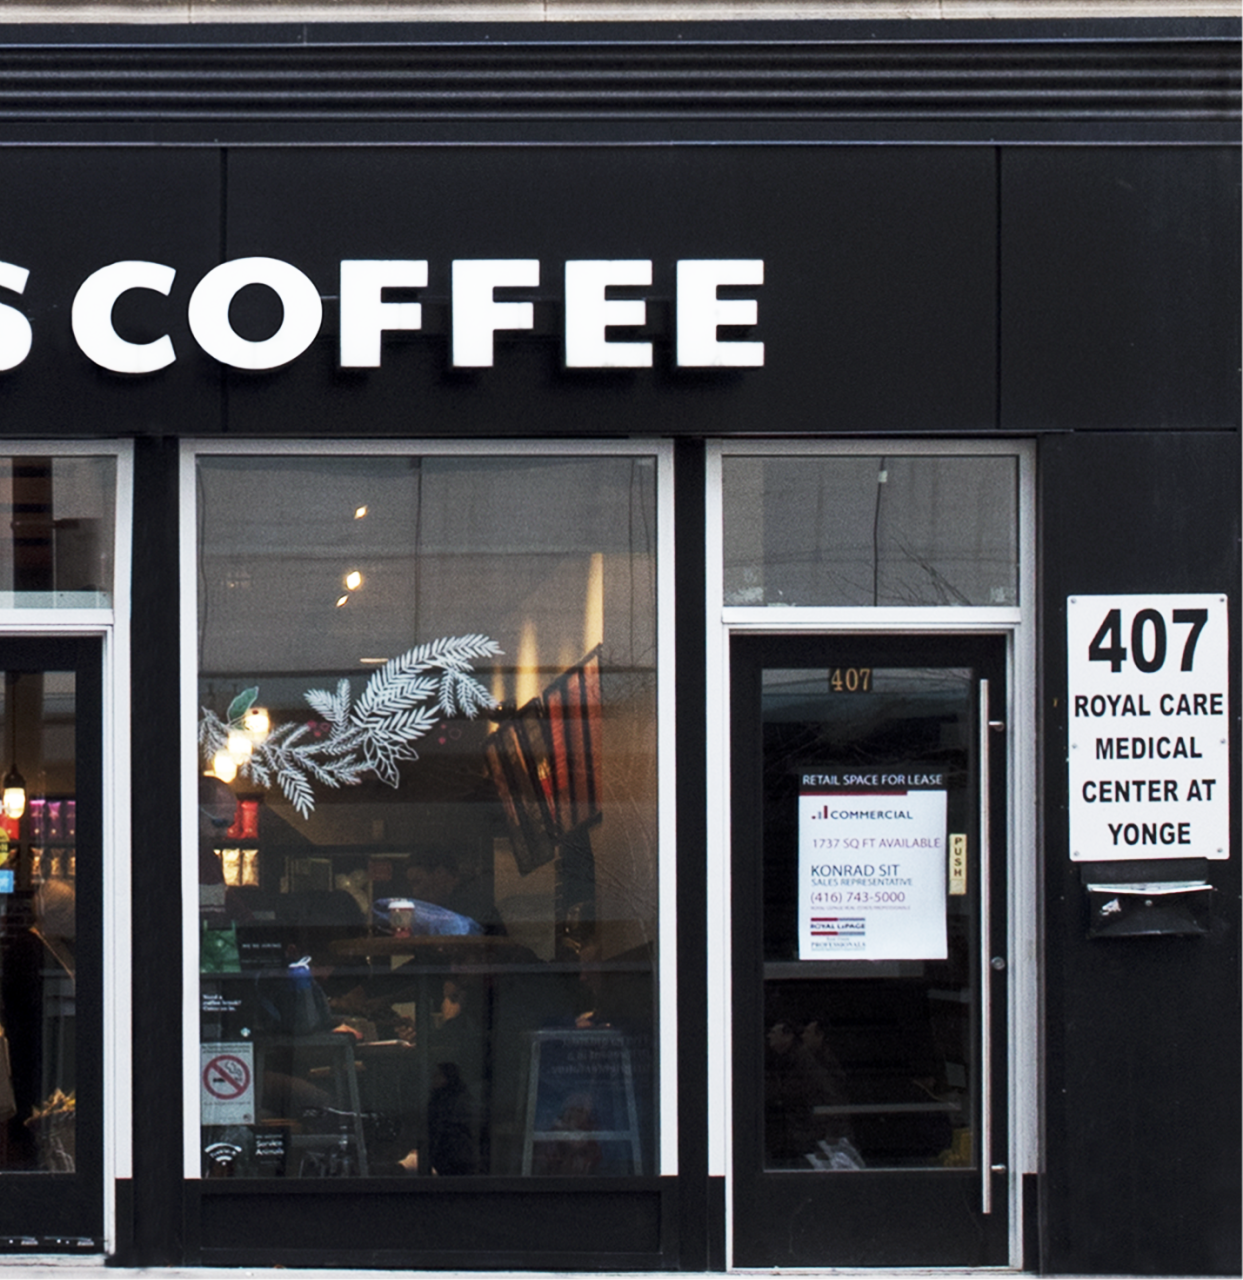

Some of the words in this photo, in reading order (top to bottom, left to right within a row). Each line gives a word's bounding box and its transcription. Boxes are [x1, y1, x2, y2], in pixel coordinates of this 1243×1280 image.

[71, 256, 764, 373] COFFEE
[1088, 608, 1209, 673] 407
[831, 668, 871, 691] 407
[1074, 694, 1151, 717] ROYAL
[1159, 693, 1223, 716] CARE
[1095, 736, 1203, 760] MEDICAL
[802, 774, 840, 785] RETAIL
[843, 774, 878, 785] SPACE
[881, 774, 906, 785] FOR
[908, 774, 943, 785] LEASE
[1082, 780, 1179, 803] CENTER
[1186, 779, 1216, 801] AT
[830, 810, 914, 820] COMMERCIAL
[812, 838, 840, 848] 1737
[843, 838, 860, 849] SQ
[862, 838, 875, 848] FT
[878, 838, 941, 848] AVAILABLE
[1108, 822, 1191, 845] YONGE
[954, 837, 963, 877] PUSH
[811, 864, 875, 877] KONRAD
[878, 864, 900, 877] SIT
[811, 878, 838, 886] SALES
[841, 878, 913, 886] REPRESENTATIVE
[810, 891, 842, 904] (416)
[846, 892, 906, 903] 743-5000
